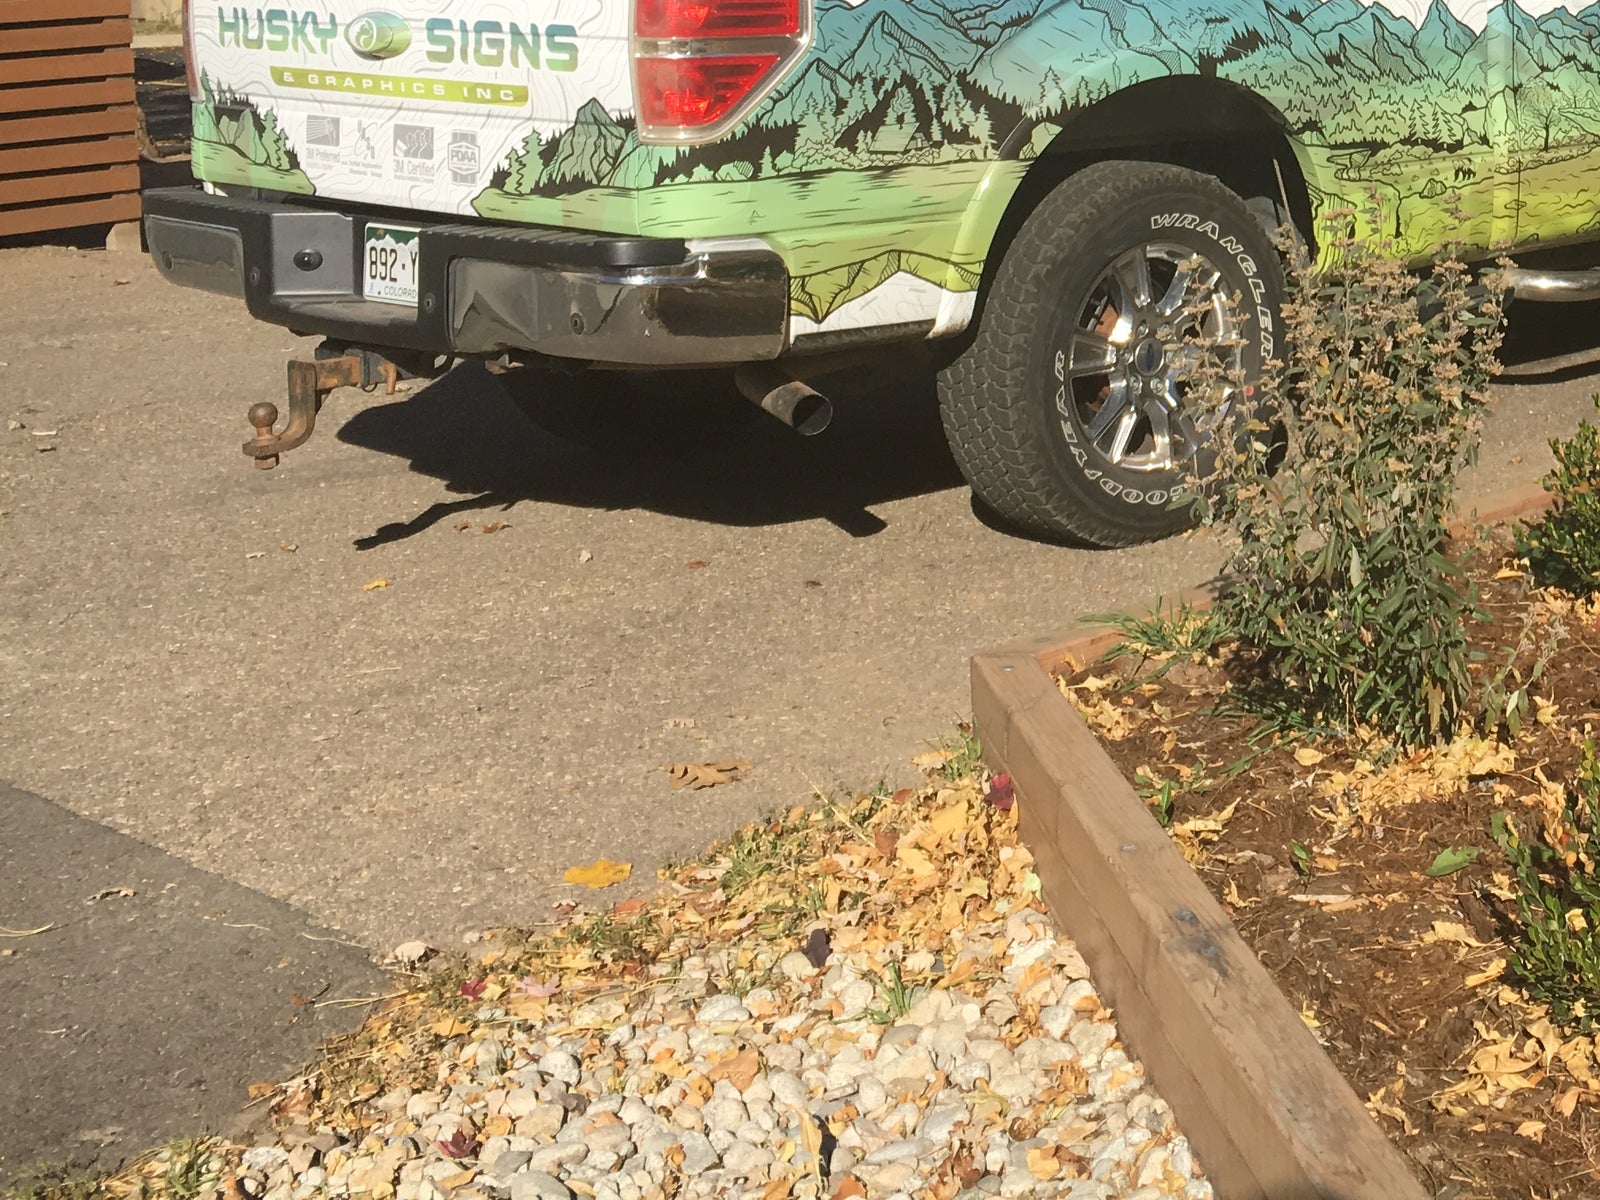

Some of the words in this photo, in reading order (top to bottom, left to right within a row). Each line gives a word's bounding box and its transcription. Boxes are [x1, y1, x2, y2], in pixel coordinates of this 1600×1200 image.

[218, 6, 338, 54] HUSKY
[425, 17, 579, 72] SIGNS
[282, 71, 295, 82] &
[308, 74, 446, 96] GRAPHICS
[463, 86, 514, 101] INC
[450, 149, 477, 163] PDAA
[384, 285, 418, 299] COLORAD
[1151, 213, 1274, 360] WRANGLER
